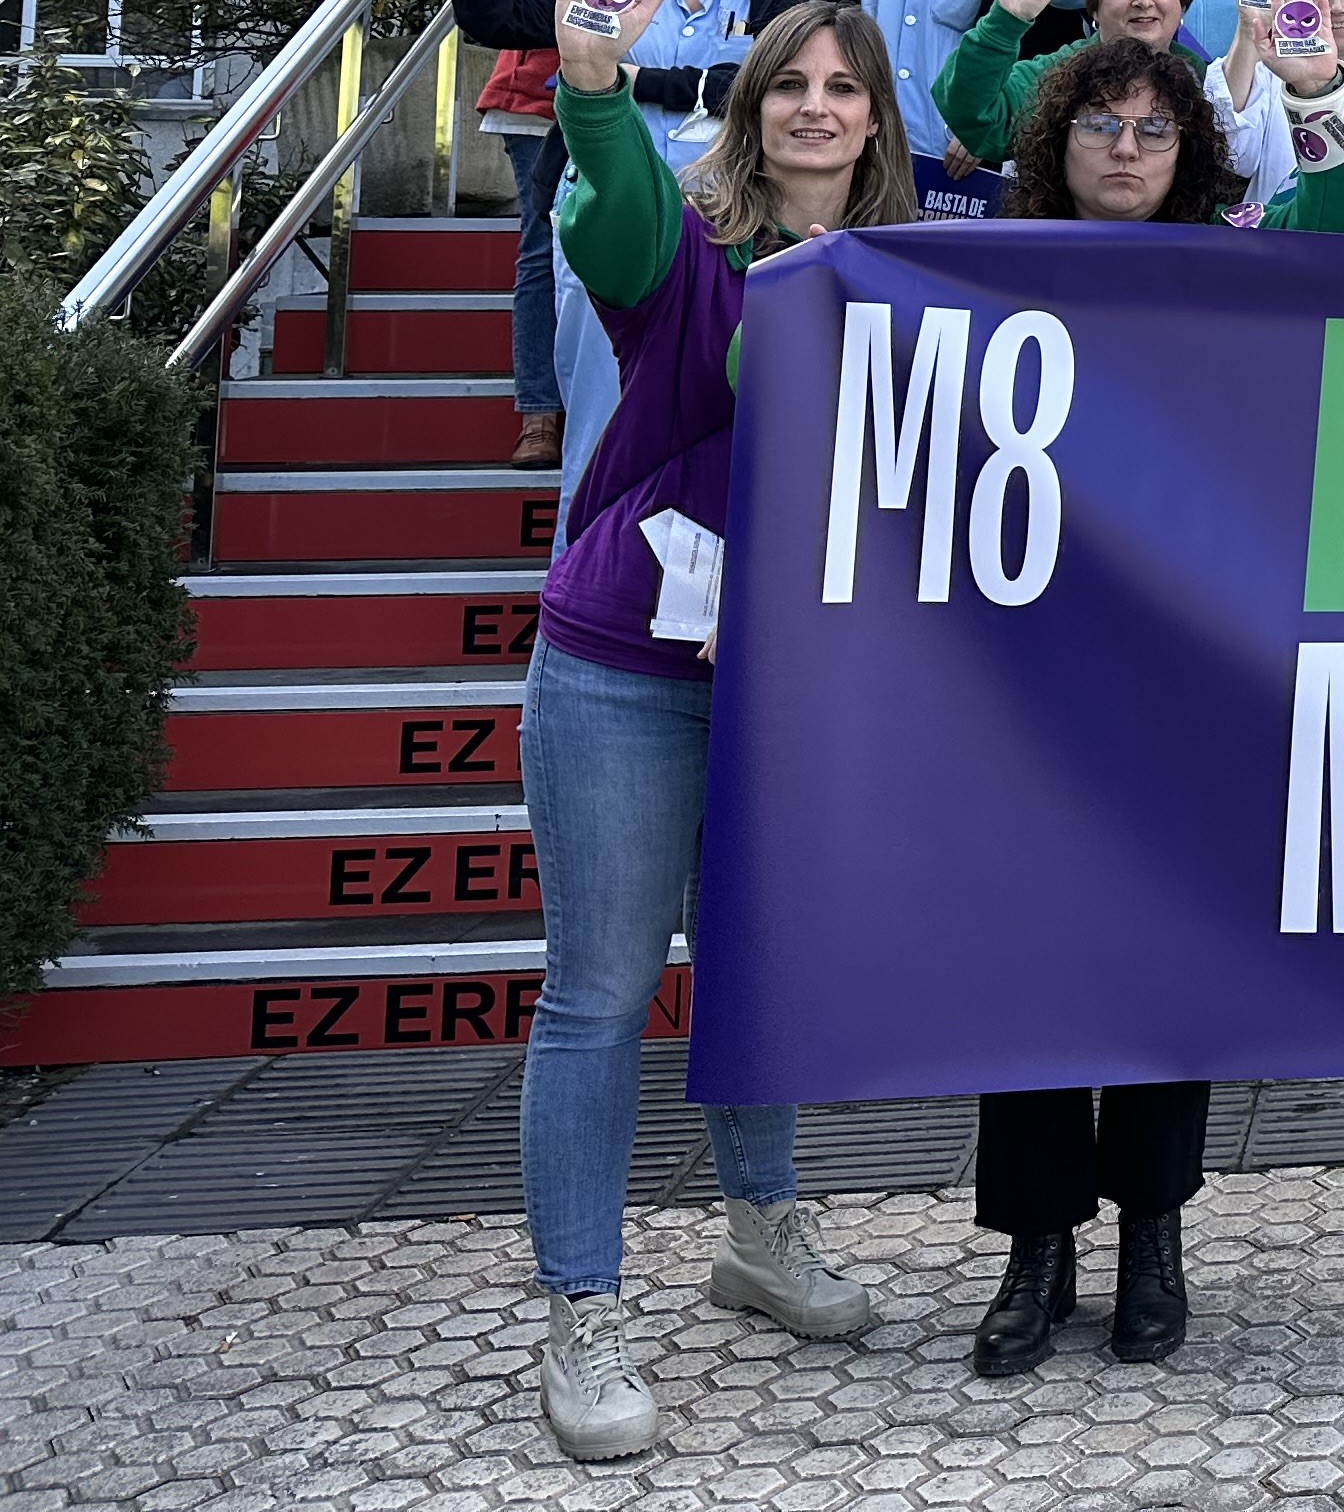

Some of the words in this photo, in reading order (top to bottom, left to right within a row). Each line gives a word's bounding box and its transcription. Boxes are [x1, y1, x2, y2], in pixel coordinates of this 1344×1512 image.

[925, 190, 967, 214] BASTA
[968, 197, 987, 218] DE
[821, 300, 1075, 607] M8
[400, 719, 495, 773] EZ
[329, 847, 432, 905] EZ
[250, 986, 360, 1049] EZ
[384, 982, 539, 1042] ERR
